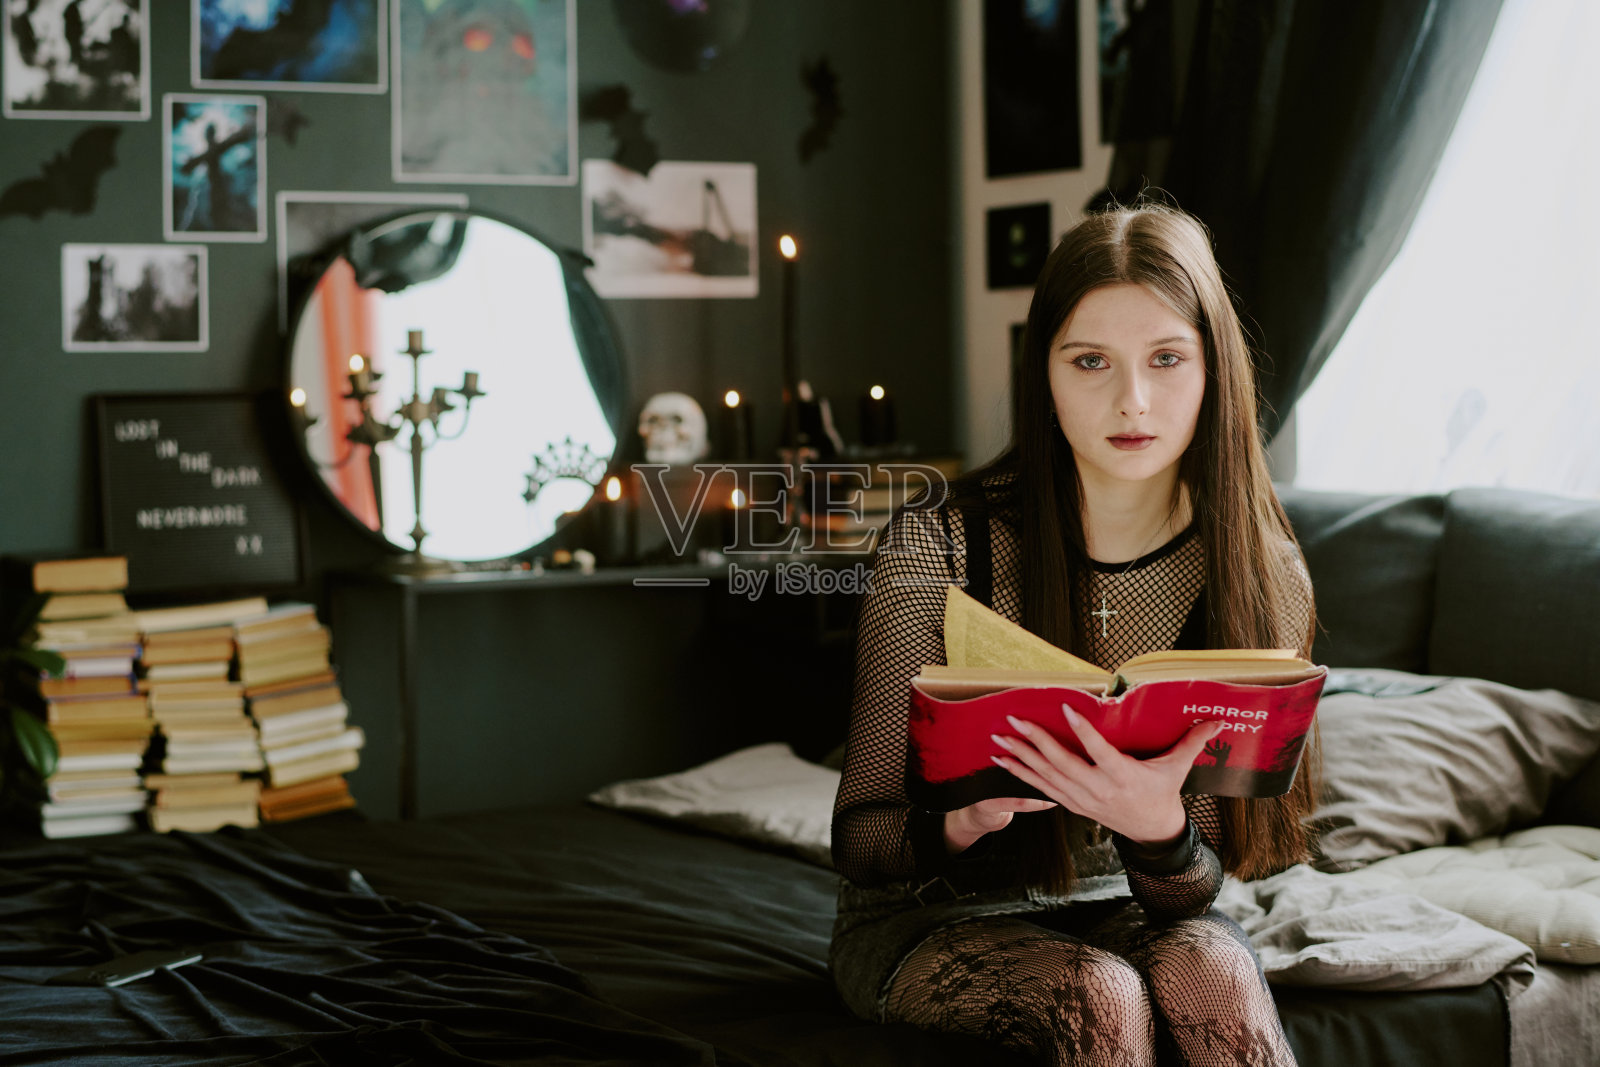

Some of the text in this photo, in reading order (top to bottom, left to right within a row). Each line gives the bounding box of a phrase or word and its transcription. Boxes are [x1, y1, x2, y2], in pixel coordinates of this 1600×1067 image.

[115, 420, 158, 441] LOST
[180, 452, 211, 474] THE
[212, 467, 261, 488] DARK
[137, 505, 246, 529] NEVERMORE
[1183, 704, 1269, 720] HORROR
